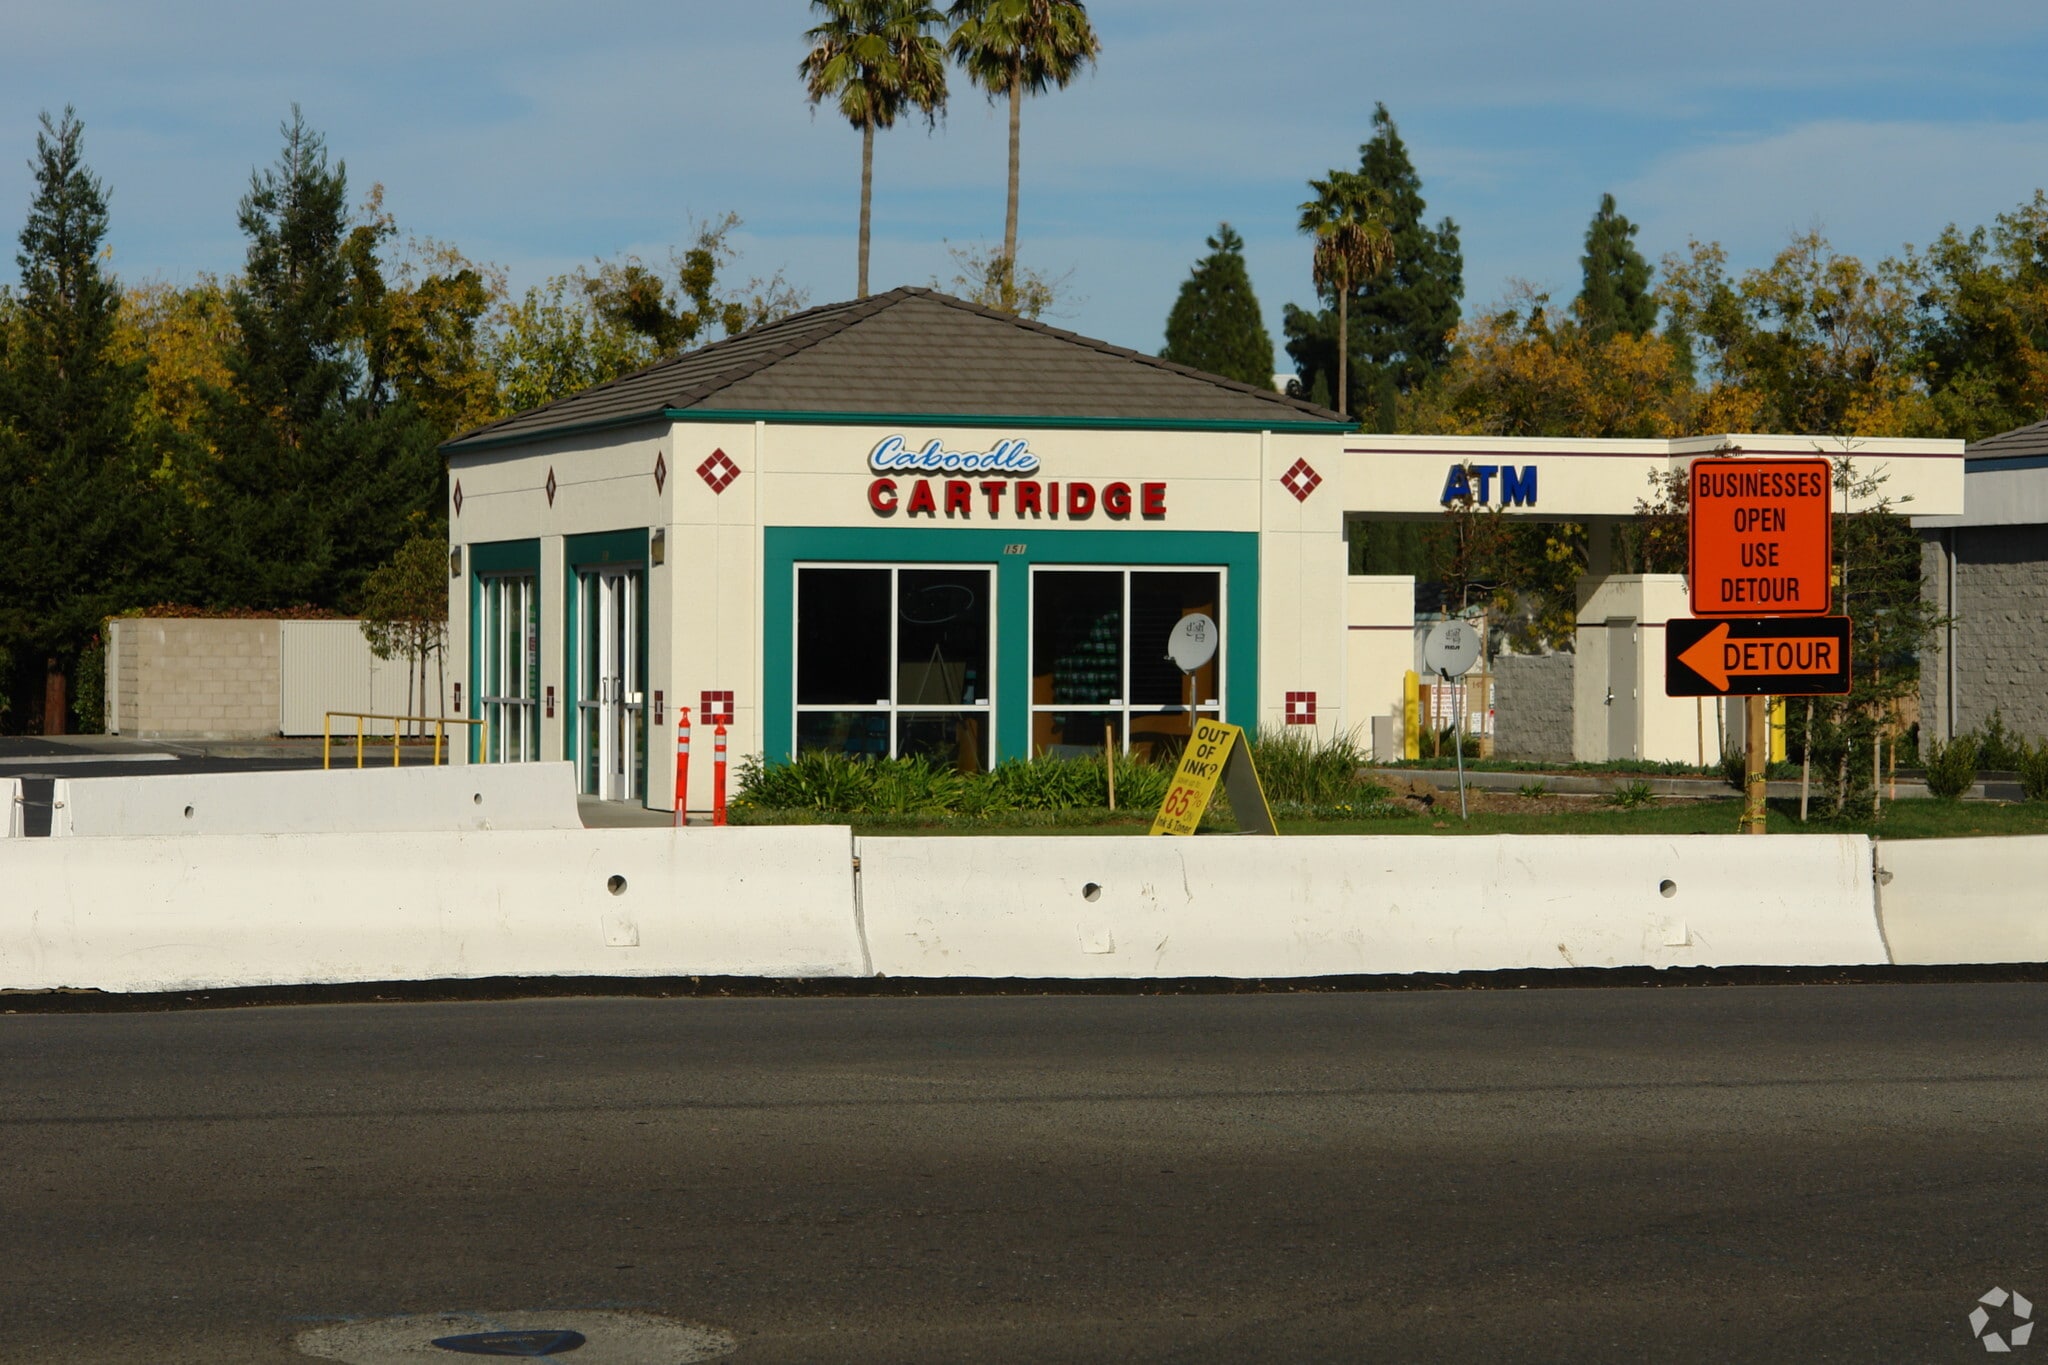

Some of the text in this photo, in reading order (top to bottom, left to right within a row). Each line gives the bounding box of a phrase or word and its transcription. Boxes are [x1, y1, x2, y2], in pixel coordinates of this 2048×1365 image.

[871, 434, 1039, 472] Caboodle
[868, 478, 1167, 517] CARTRIDGE
[1441, 465, 1537, 504] ATM
[1699, 472, 1822, 498] BUSINESSES
[1734, 507, 1786, 533] OPEN
[1741, 542, 1779, 567] USE
[1721, 577, 1799, 603] DETOUR
[1723, 642, 1831, 671] DETOUR
[1198, 726, 1230, 745] OUT
[1196, 744, 1216, 760] OF
[1183, 759, 1218, 781] INK?
[1165, 786, 1203, 817] 65%
